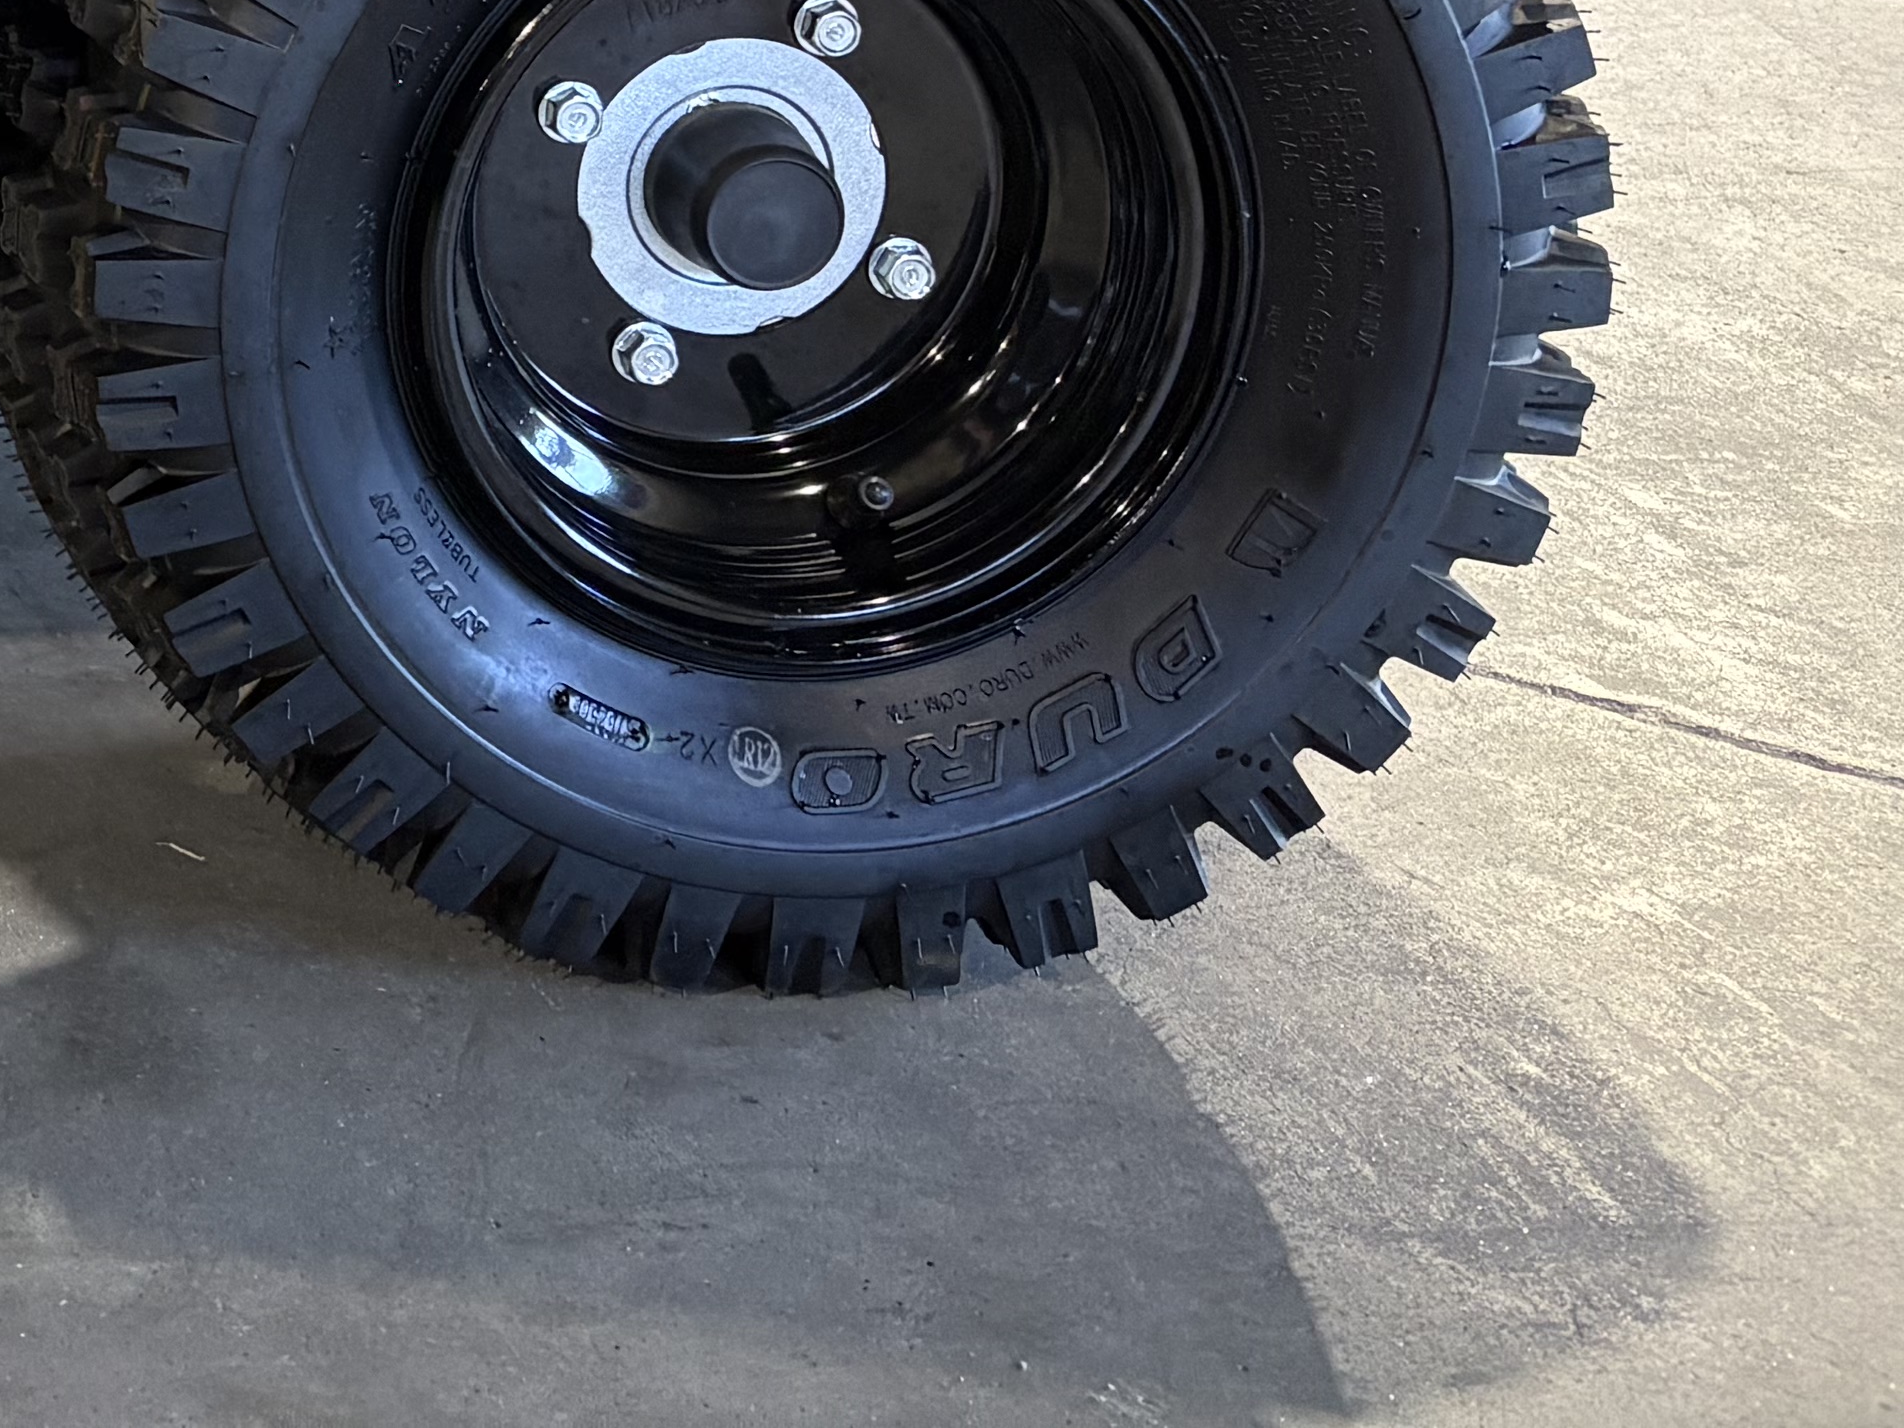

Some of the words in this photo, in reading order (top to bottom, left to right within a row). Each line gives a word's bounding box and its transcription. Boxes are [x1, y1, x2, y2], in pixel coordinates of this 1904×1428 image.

[370, 485, 492, 643] NYLON
[414, 488, 482, 581] TUBELESS
[790, 594, 1222, 815] DURO
